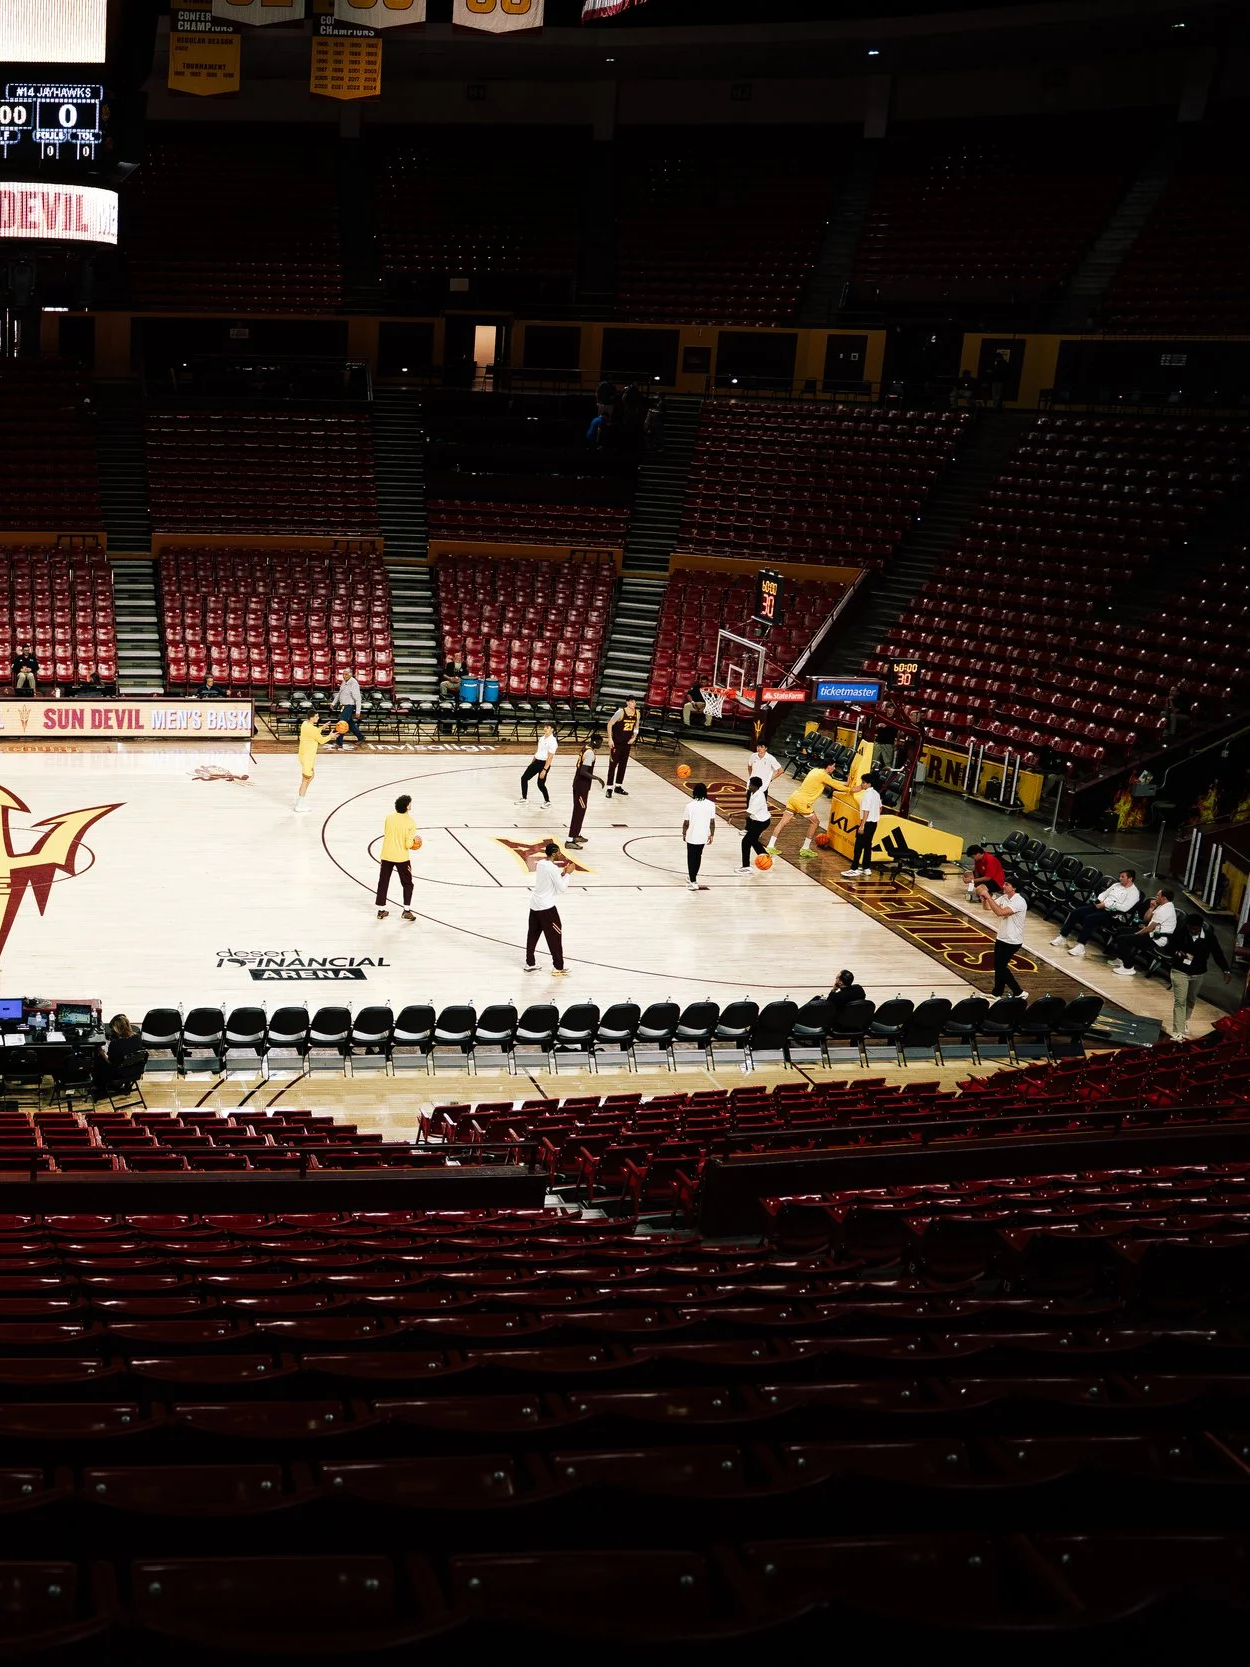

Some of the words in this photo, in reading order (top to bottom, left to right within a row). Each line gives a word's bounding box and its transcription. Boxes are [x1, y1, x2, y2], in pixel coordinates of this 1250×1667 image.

[178, 11, 211, 21] CONFER
[16, 87, 34, 96] #14
[36, 87, 91, 98] JAYHAWKS
[58, 104, 78, 128] 0
[36, 132, 65, 140] FOULS
[77, 132, 94, 140] TOL
[47, 146, 54, 156] 0
[83, 146, 89, 156] 0
[762, 594, 775, 618] 30
[898, 674, 911, 686] 30
[820, 686, 876, 697] ticketmaster
[43, 708, 84, 729] SUN
[90, 708, 144, 730] DEVIL
[152, 710, 202, 730] MEN'S
[207, 710, 251, 730] BASK
[367, 743, 496, 752] invisalign
[828, 879, 1038, 973] DEVILS
[216, 948, 302, 957] desert
[262, 970, 356, 979] ARENA
